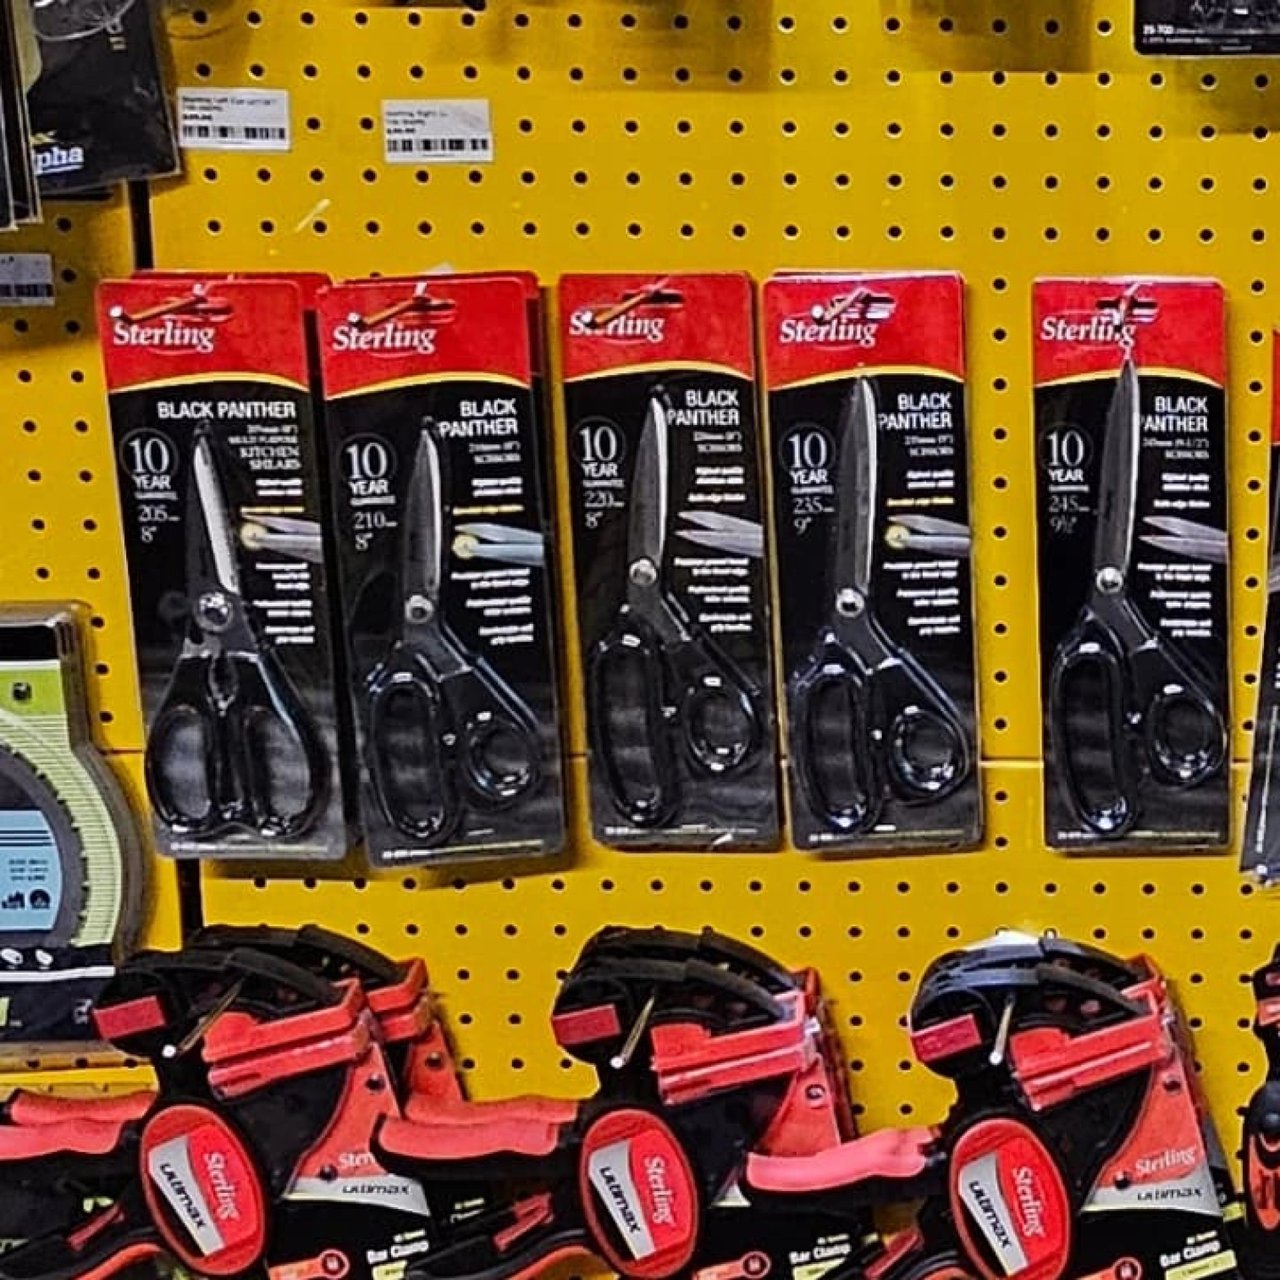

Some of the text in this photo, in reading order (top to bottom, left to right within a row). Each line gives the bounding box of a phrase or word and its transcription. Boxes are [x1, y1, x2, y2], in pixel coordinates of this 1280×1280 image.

[36, 148, 84, 174] pha
[113, 321, 215, 353] Sterling
[332, 323, 437, 355] Sterling
[569, 311, 665, 342] Srling
[780, 318, 878, 348] Sterling
[1041, 316, 1137, 348] Sterling
[158, 401, 297, 419] BLACK PANTHER
[460, 399, 517, 417] BLACK
[686, 389, 739, 407] BLACK
[898, 392, 952, 410] BLACK
[1155, 396, 1209, 413] BLACK
[439, 418, 519, 437] PANTHER
[667, 408, 740, 426] PANTHER
[1141, 415, 1208, 433] ANTHER
[129, 437, 170, 474] 10
[240, 446, 300, 459] KITCHEN
[579, 425, 617, 463] 10
[786, 432, 828, 470] 10
[1046, 431, 1085, 468] 10
[345, 442, 388, 479] 10
[581, 462, 618, 477] YEAR
[132, 475, 172, 490] YEAR
[350, 479, 390, 495] YEAR
[790, 471, 829, 485] YEAR
[1048, 469, 1085, 483] YEAR
[1135, 1147, 1198, 1174] Sterling
[159, 1161, 207, 1231] ultimax
[203, 1151, 240, 1221] Sterling
[643, 1153, 675, 1227] Sterling
[968, 1179, 1012, 1252] ultimax
[1011, 1165, 1046, 1239] Sterling
